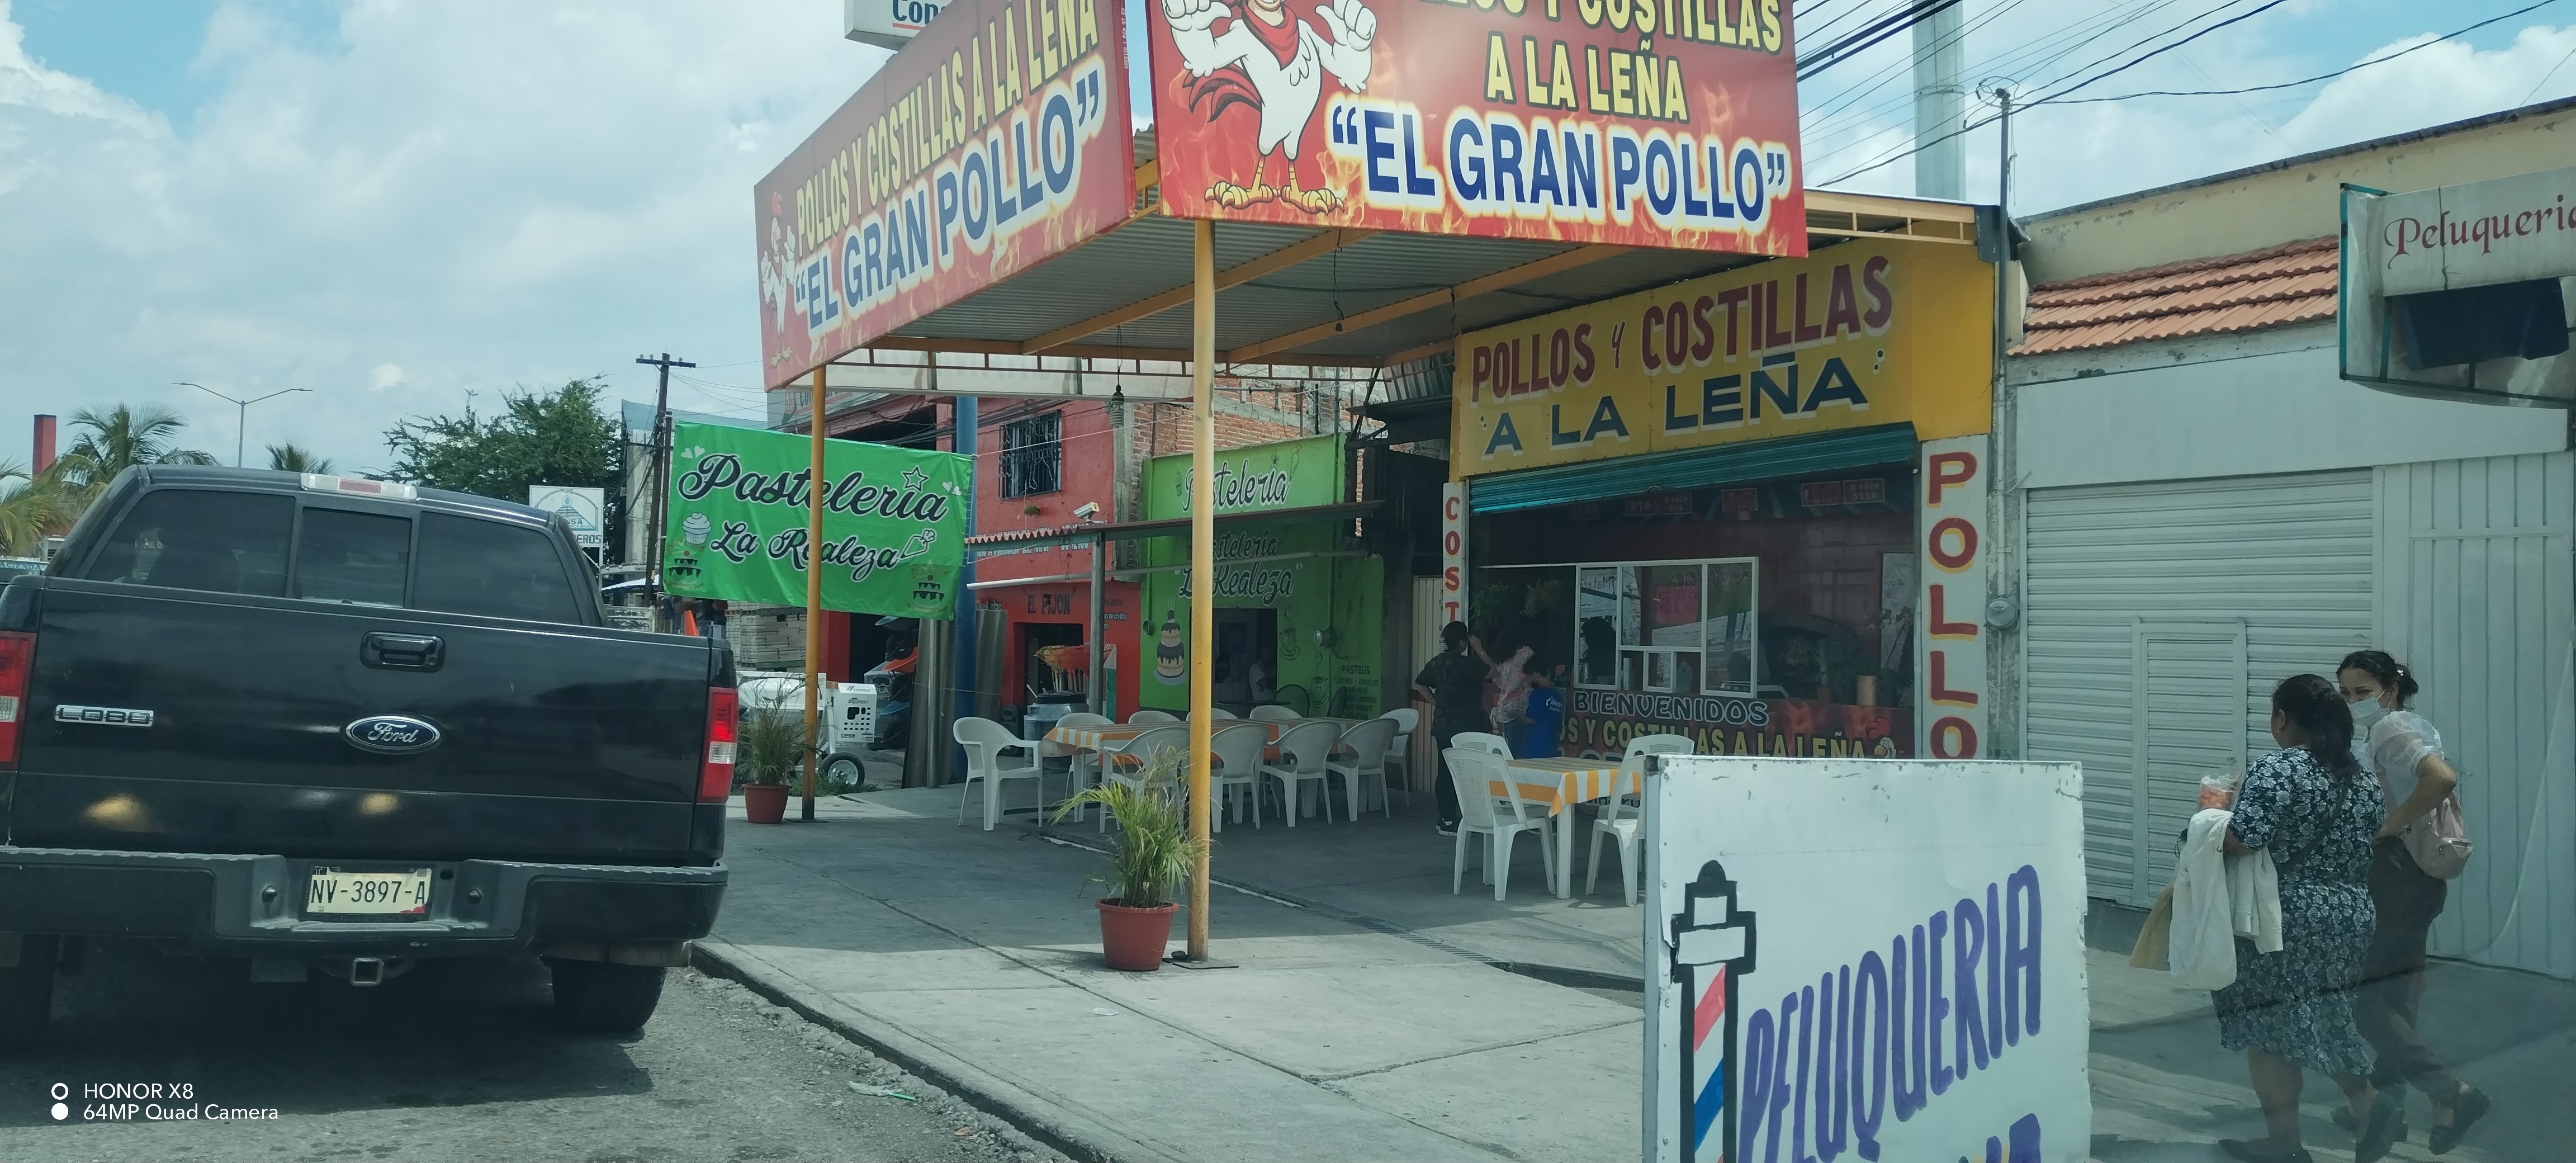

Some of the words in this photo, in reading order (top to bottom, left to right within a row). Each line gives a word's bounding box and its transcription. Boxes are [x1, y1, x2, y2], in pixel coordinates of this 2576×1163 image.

[1488, 36, 1513, 101] A
[1523, 40, 1576, 108] LA
[1588, 39, 1687, 120] LEÑA
[797, 149, 850, 257] POLLOS
[852, 137, 862, 215] Y
[867, 51, 966, 206] COSTILLAS
[973, 36, 987, 132] A
[989, 7, 1022, 116] LA
[1450, 117, 1598, 209] GRAN
[844, 189, 929, 308] GRAN
[1471, 323, 1595, 404] POLLOS
[1642, 256, 1892, 370] COSTILLAS
[1483, 412, 1522, 456] A
[1551, 395, 1630, 447] LA
[1665, 352, 1869, 431] LEÑA
[678, 455, 949, 521] Pastleria
[1182, 460, 1288, 511] Psteleria
[575, 534, 602, 544] EROS
[712, 522, 758, 562] La
[59, 707, 150, 725] LOBO
[367, 722, 419, 743] Ford
[1574, 691, 1769, 726] BIENVENIDOS
[1584, 718, 1597, 744] Y
[311, 879, 420, 904] NV-3897-A
[1737, 864, 2042, 1163] PELUQUERIA
